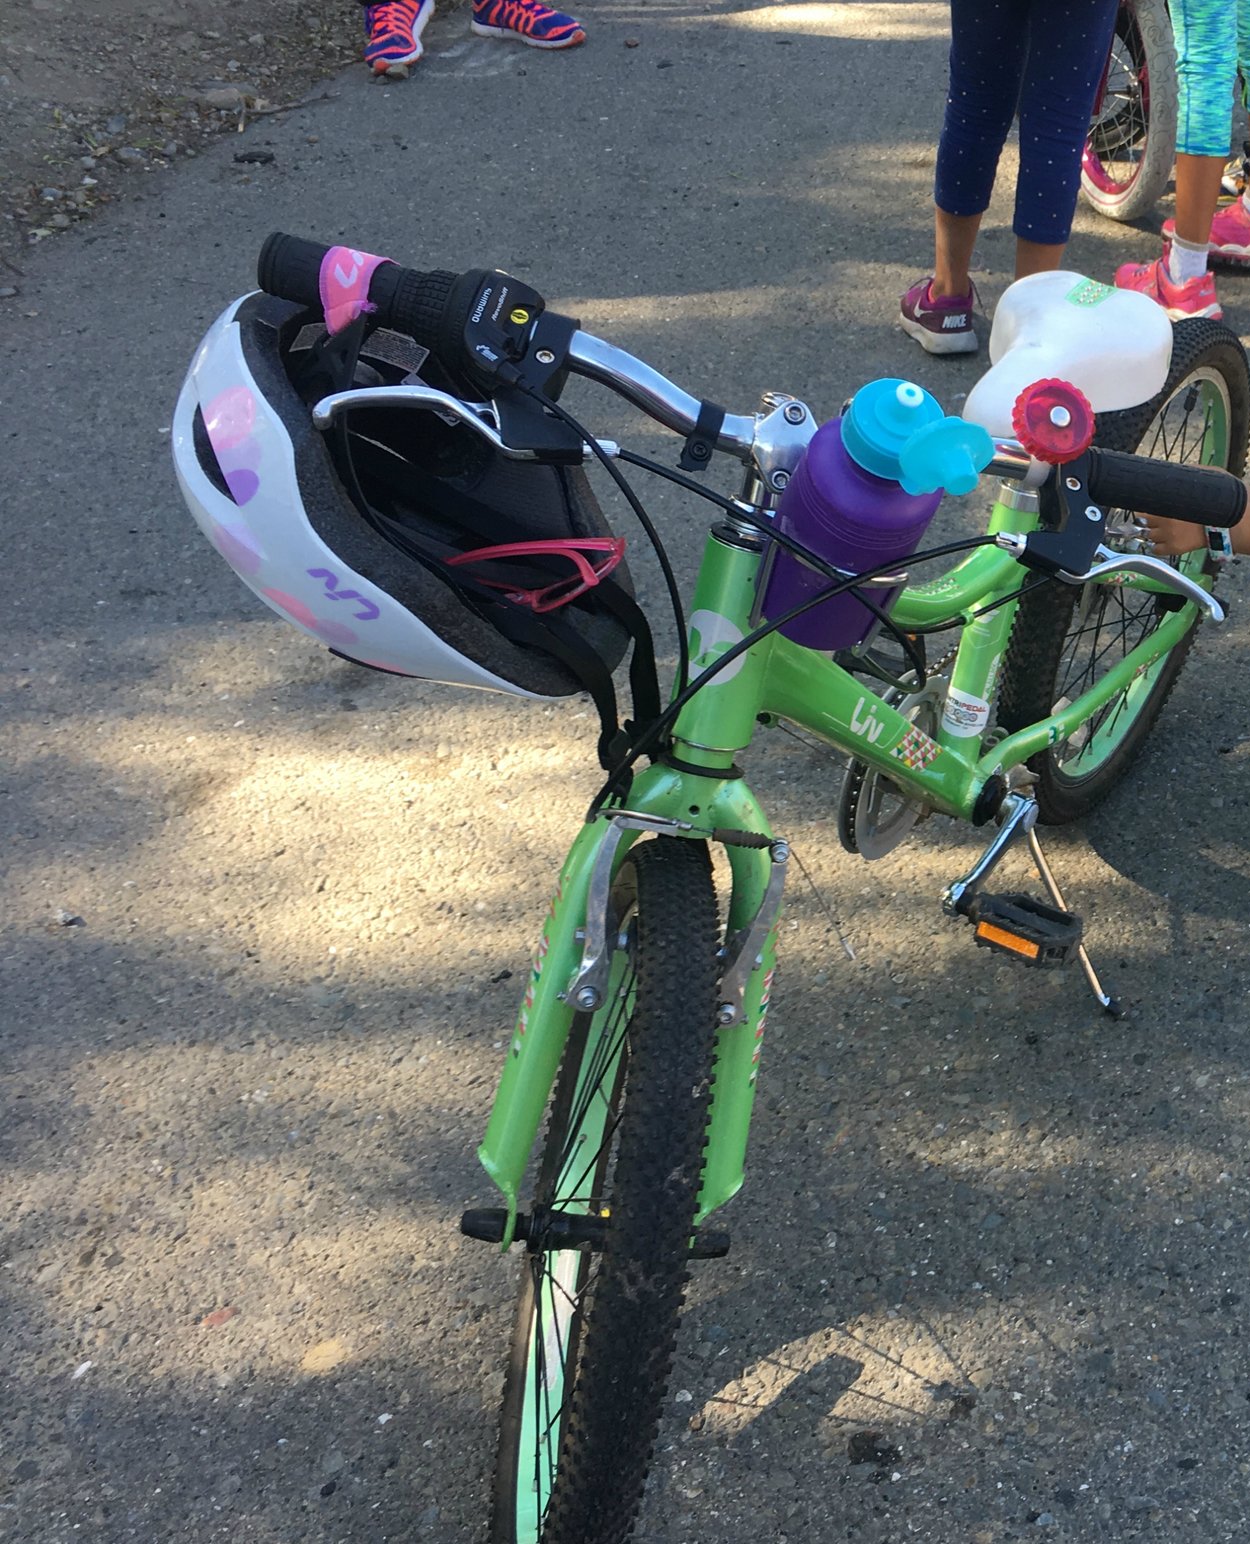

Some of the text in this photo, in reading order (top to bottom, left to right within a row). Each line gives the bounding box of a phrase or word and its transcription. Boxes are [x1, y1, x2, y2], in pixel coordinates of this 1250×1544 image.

[471, 287, 493, 323] SHIMANO
[491, 286, 509, 322] RevoShift
[942, 314, 967, 329] NIKE
[306, 567, 380, 621] Liv
[850, 696, 885, 744] Liv
